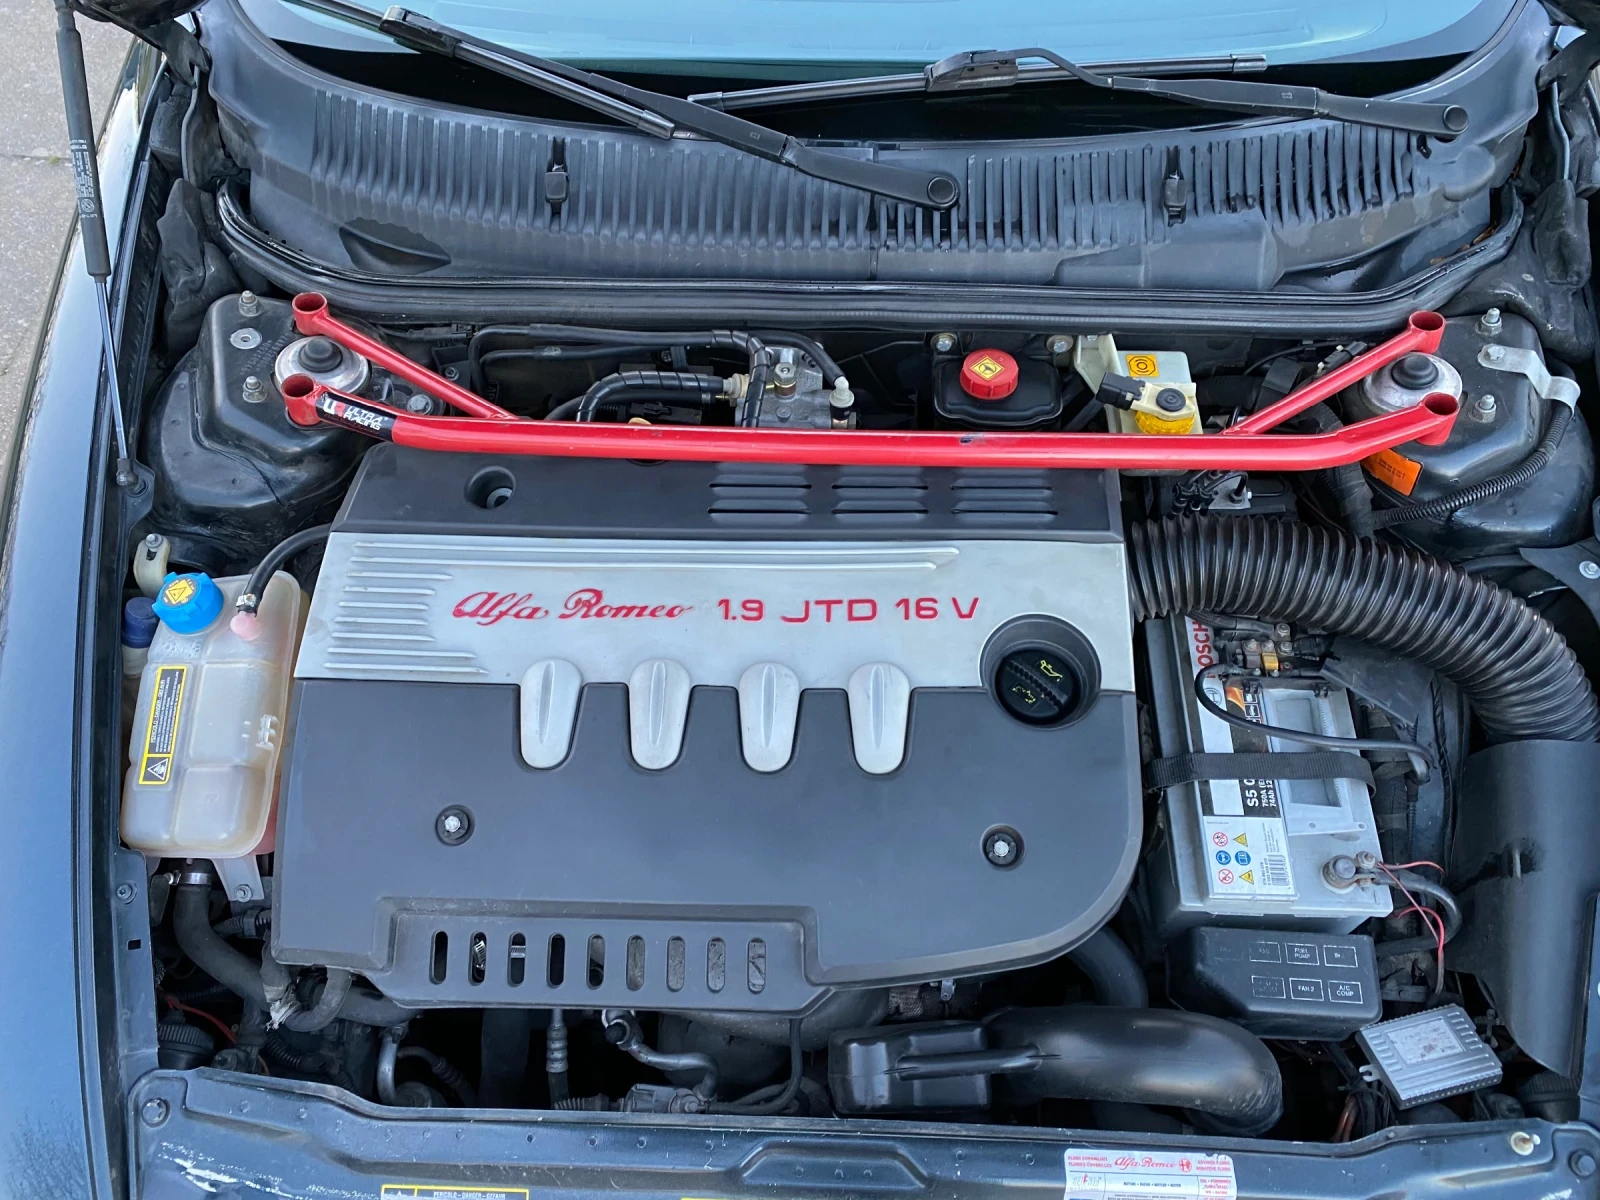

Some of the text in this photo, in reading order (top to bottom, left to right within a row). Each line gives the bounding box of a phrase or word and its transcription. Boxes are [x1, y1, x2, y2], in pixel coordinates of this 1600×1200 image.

[343, 412, 382, 431] RACING
[347, 405, 383, 422] ULTRA
[452, 588, 979, 626] Alfa Romeo 1.9 JTD 16 V
[1192, 619, 1216, 679] OSCH
[1246, 789, 1259, 807] S5
[1268, 790, 1277, 808] 74Ah
[1114, 1157, 1178, 1171] Alfa Romeo
[434, 1191, 457, 1199] PERICOLO
